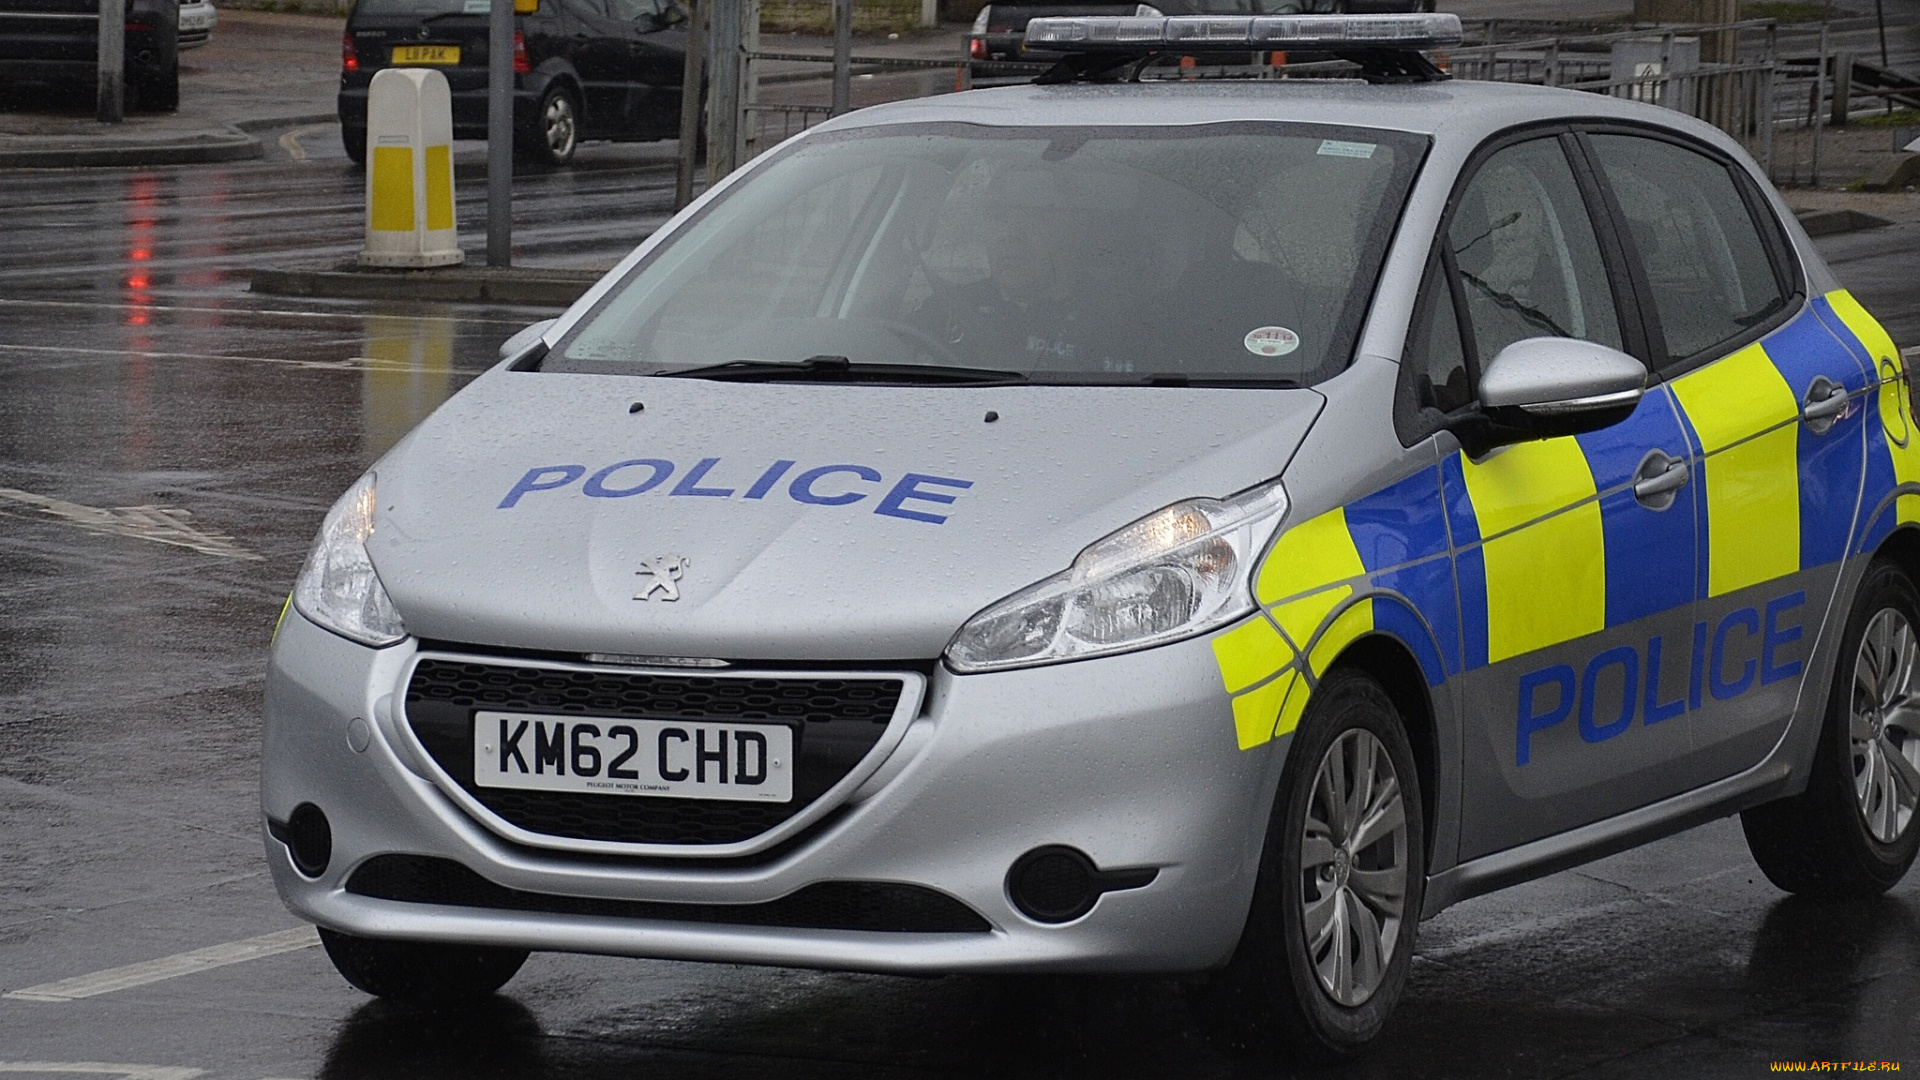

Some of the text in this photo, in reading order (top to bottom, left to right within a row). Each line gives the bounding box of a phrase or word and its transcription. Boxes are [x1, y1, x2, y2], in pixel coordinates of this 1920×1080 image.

[496, 457, 975, 525] POLICE
[1516, 589, 1806, 768] POLICE
[499, 719, 767, 786] KM62 CHD
[586, 781, 614, 789] PEUGEOT
